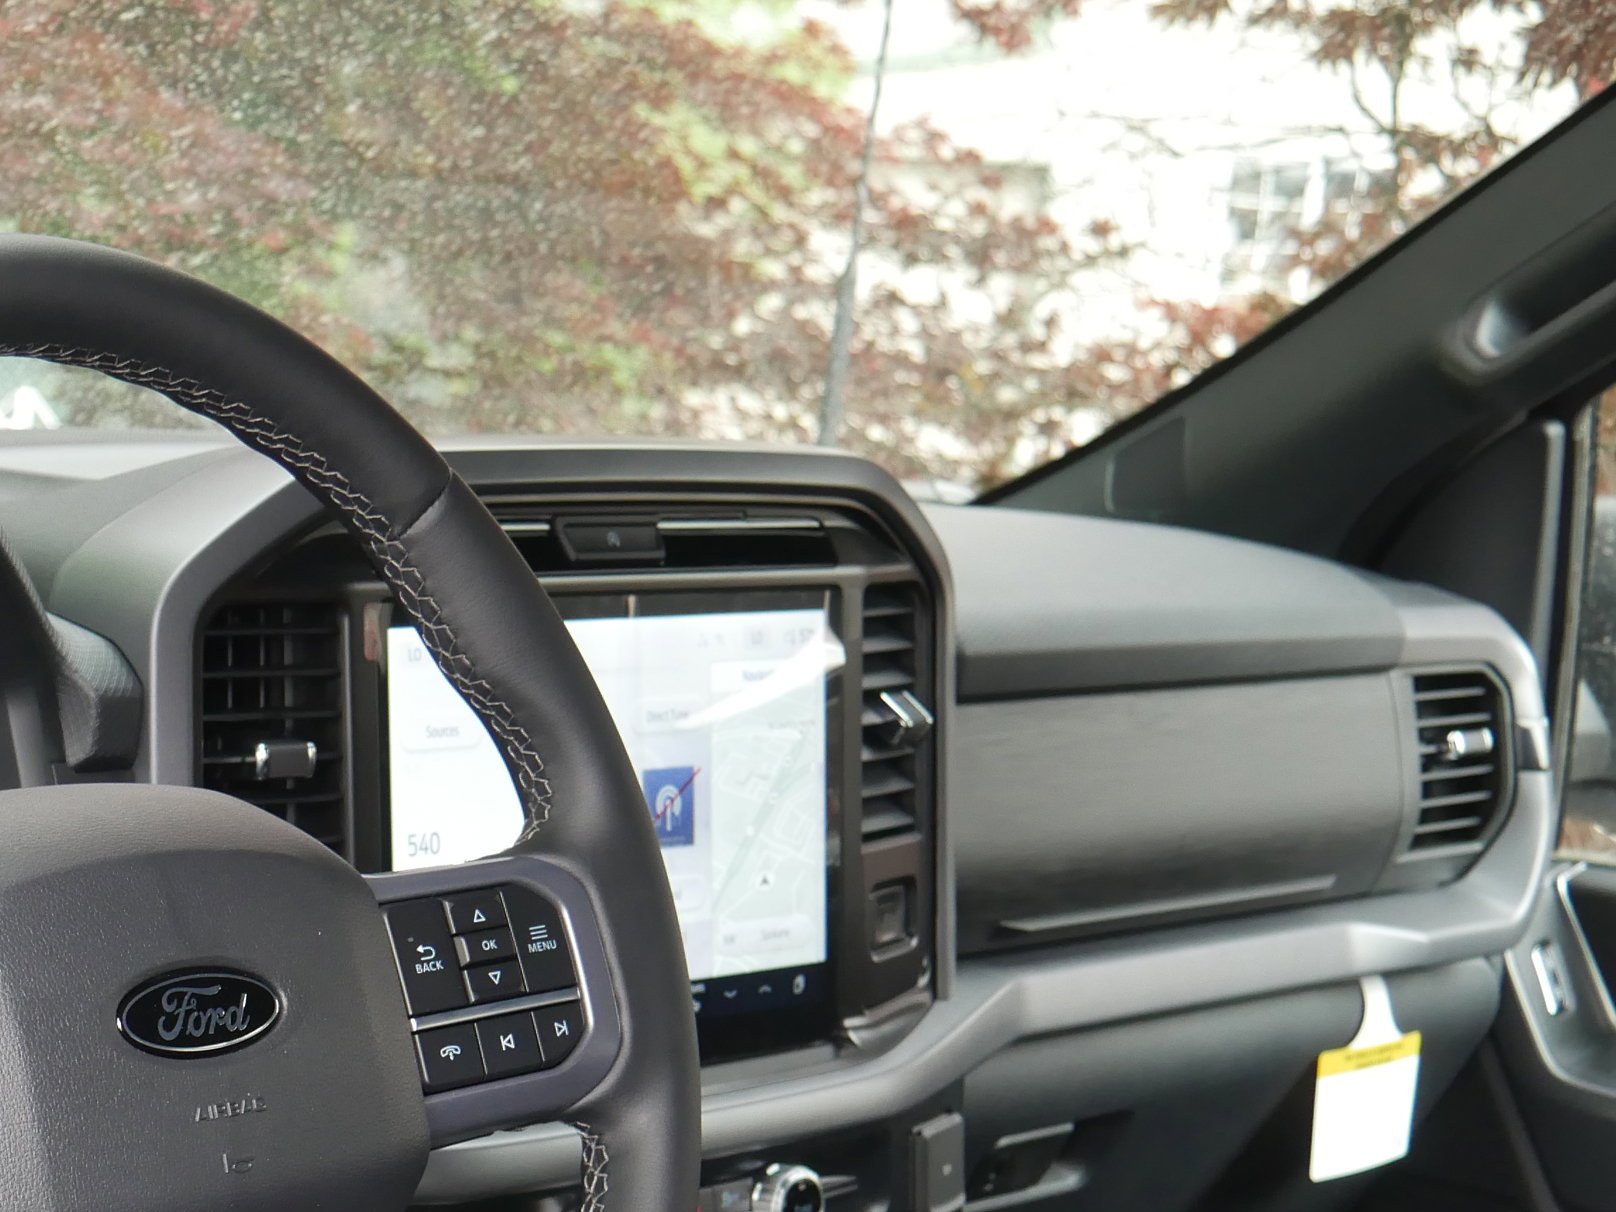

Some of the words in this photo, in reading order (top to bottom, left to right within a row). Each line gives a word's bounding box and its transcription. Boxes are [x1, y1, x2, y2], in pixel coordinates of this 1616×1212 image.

[425, 725, 460, 739] Sources
[407, 831, 441, 857] 540
[481, 939, 498, 951] OK
[527, 940, 557, 954] MENU
[415, 960, 444, 974] BACK
[158, 984, 251, 1041] Ford
